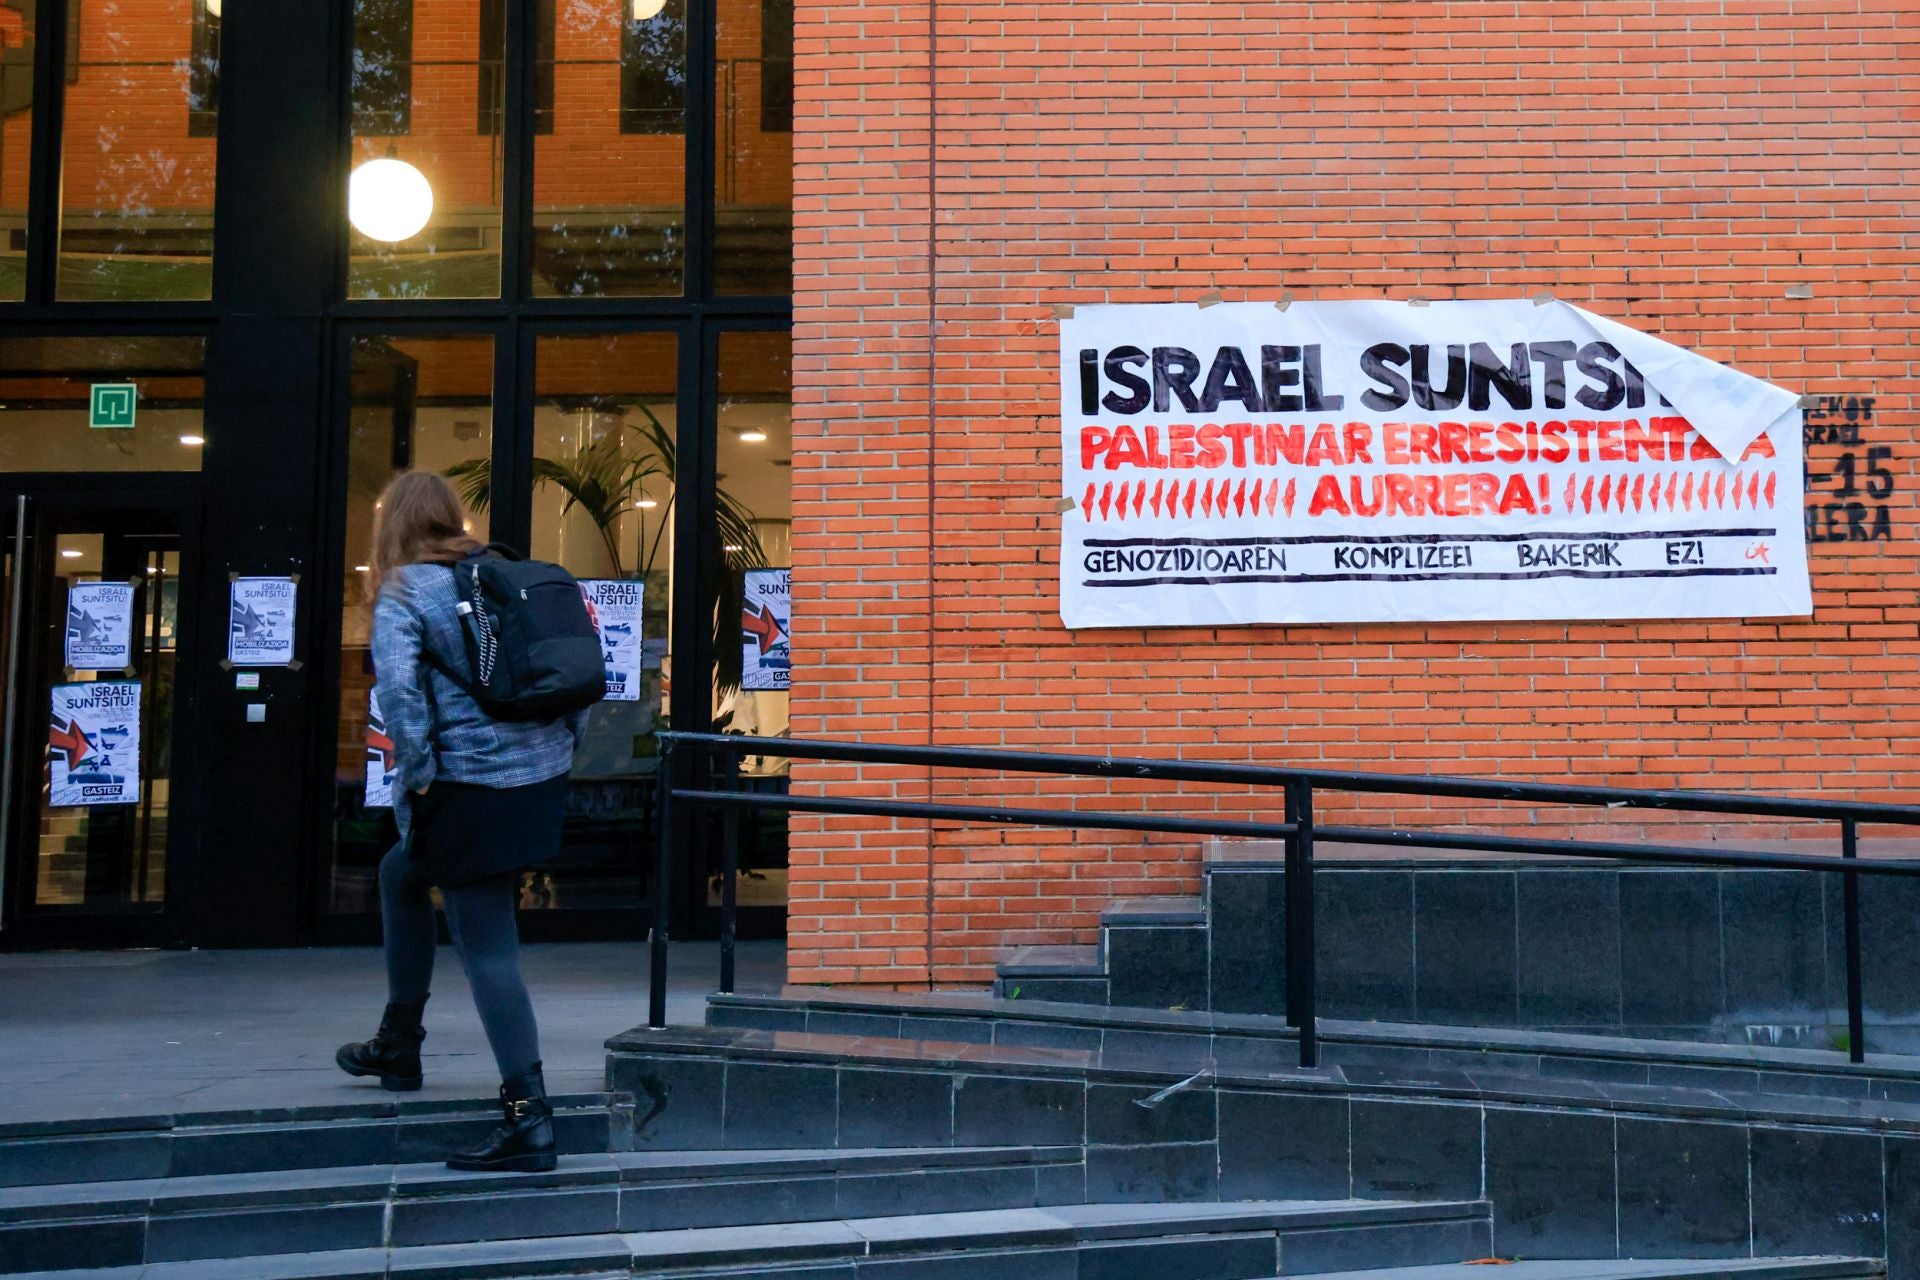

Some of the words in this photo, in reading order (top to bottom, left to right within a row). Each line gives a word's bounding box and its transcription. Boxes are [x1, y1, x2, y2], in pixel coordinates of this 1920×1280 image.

[1080, 344, 1345, 416] ISRAEL
[1360, 340, 1673, 412] SUNTSI
[1081, 422, 1374, 470] PALESTINAR
[1805, 447, 1894, 499] -15
[1308, 472, 1552, 518] AURRERA!
[1805, 502, 1892, 543] LERA
[1084, 546, 1287, 573] GENOZIDIOAREN
[1334, 544, 1472, 569] KONPLIZEEI
[1517, 541, 1622, 568] BAKERIK
[1665, 540, 1704, 565] EZ!
[99, 587, 129, 596] ISRAEL
[262, 582, 291, 590] ISRAEL
[596, 584, 638, 595] ISRAEL
[590, 595, 637, 605] NTSITU!
[91, 685, 135, 697] ISRAEL
[606, 684, 623, 692] TEIZ
[66, 696, 134, 709] SUNTSITU!
[84, 785, 121, 796] GASTEIZ
